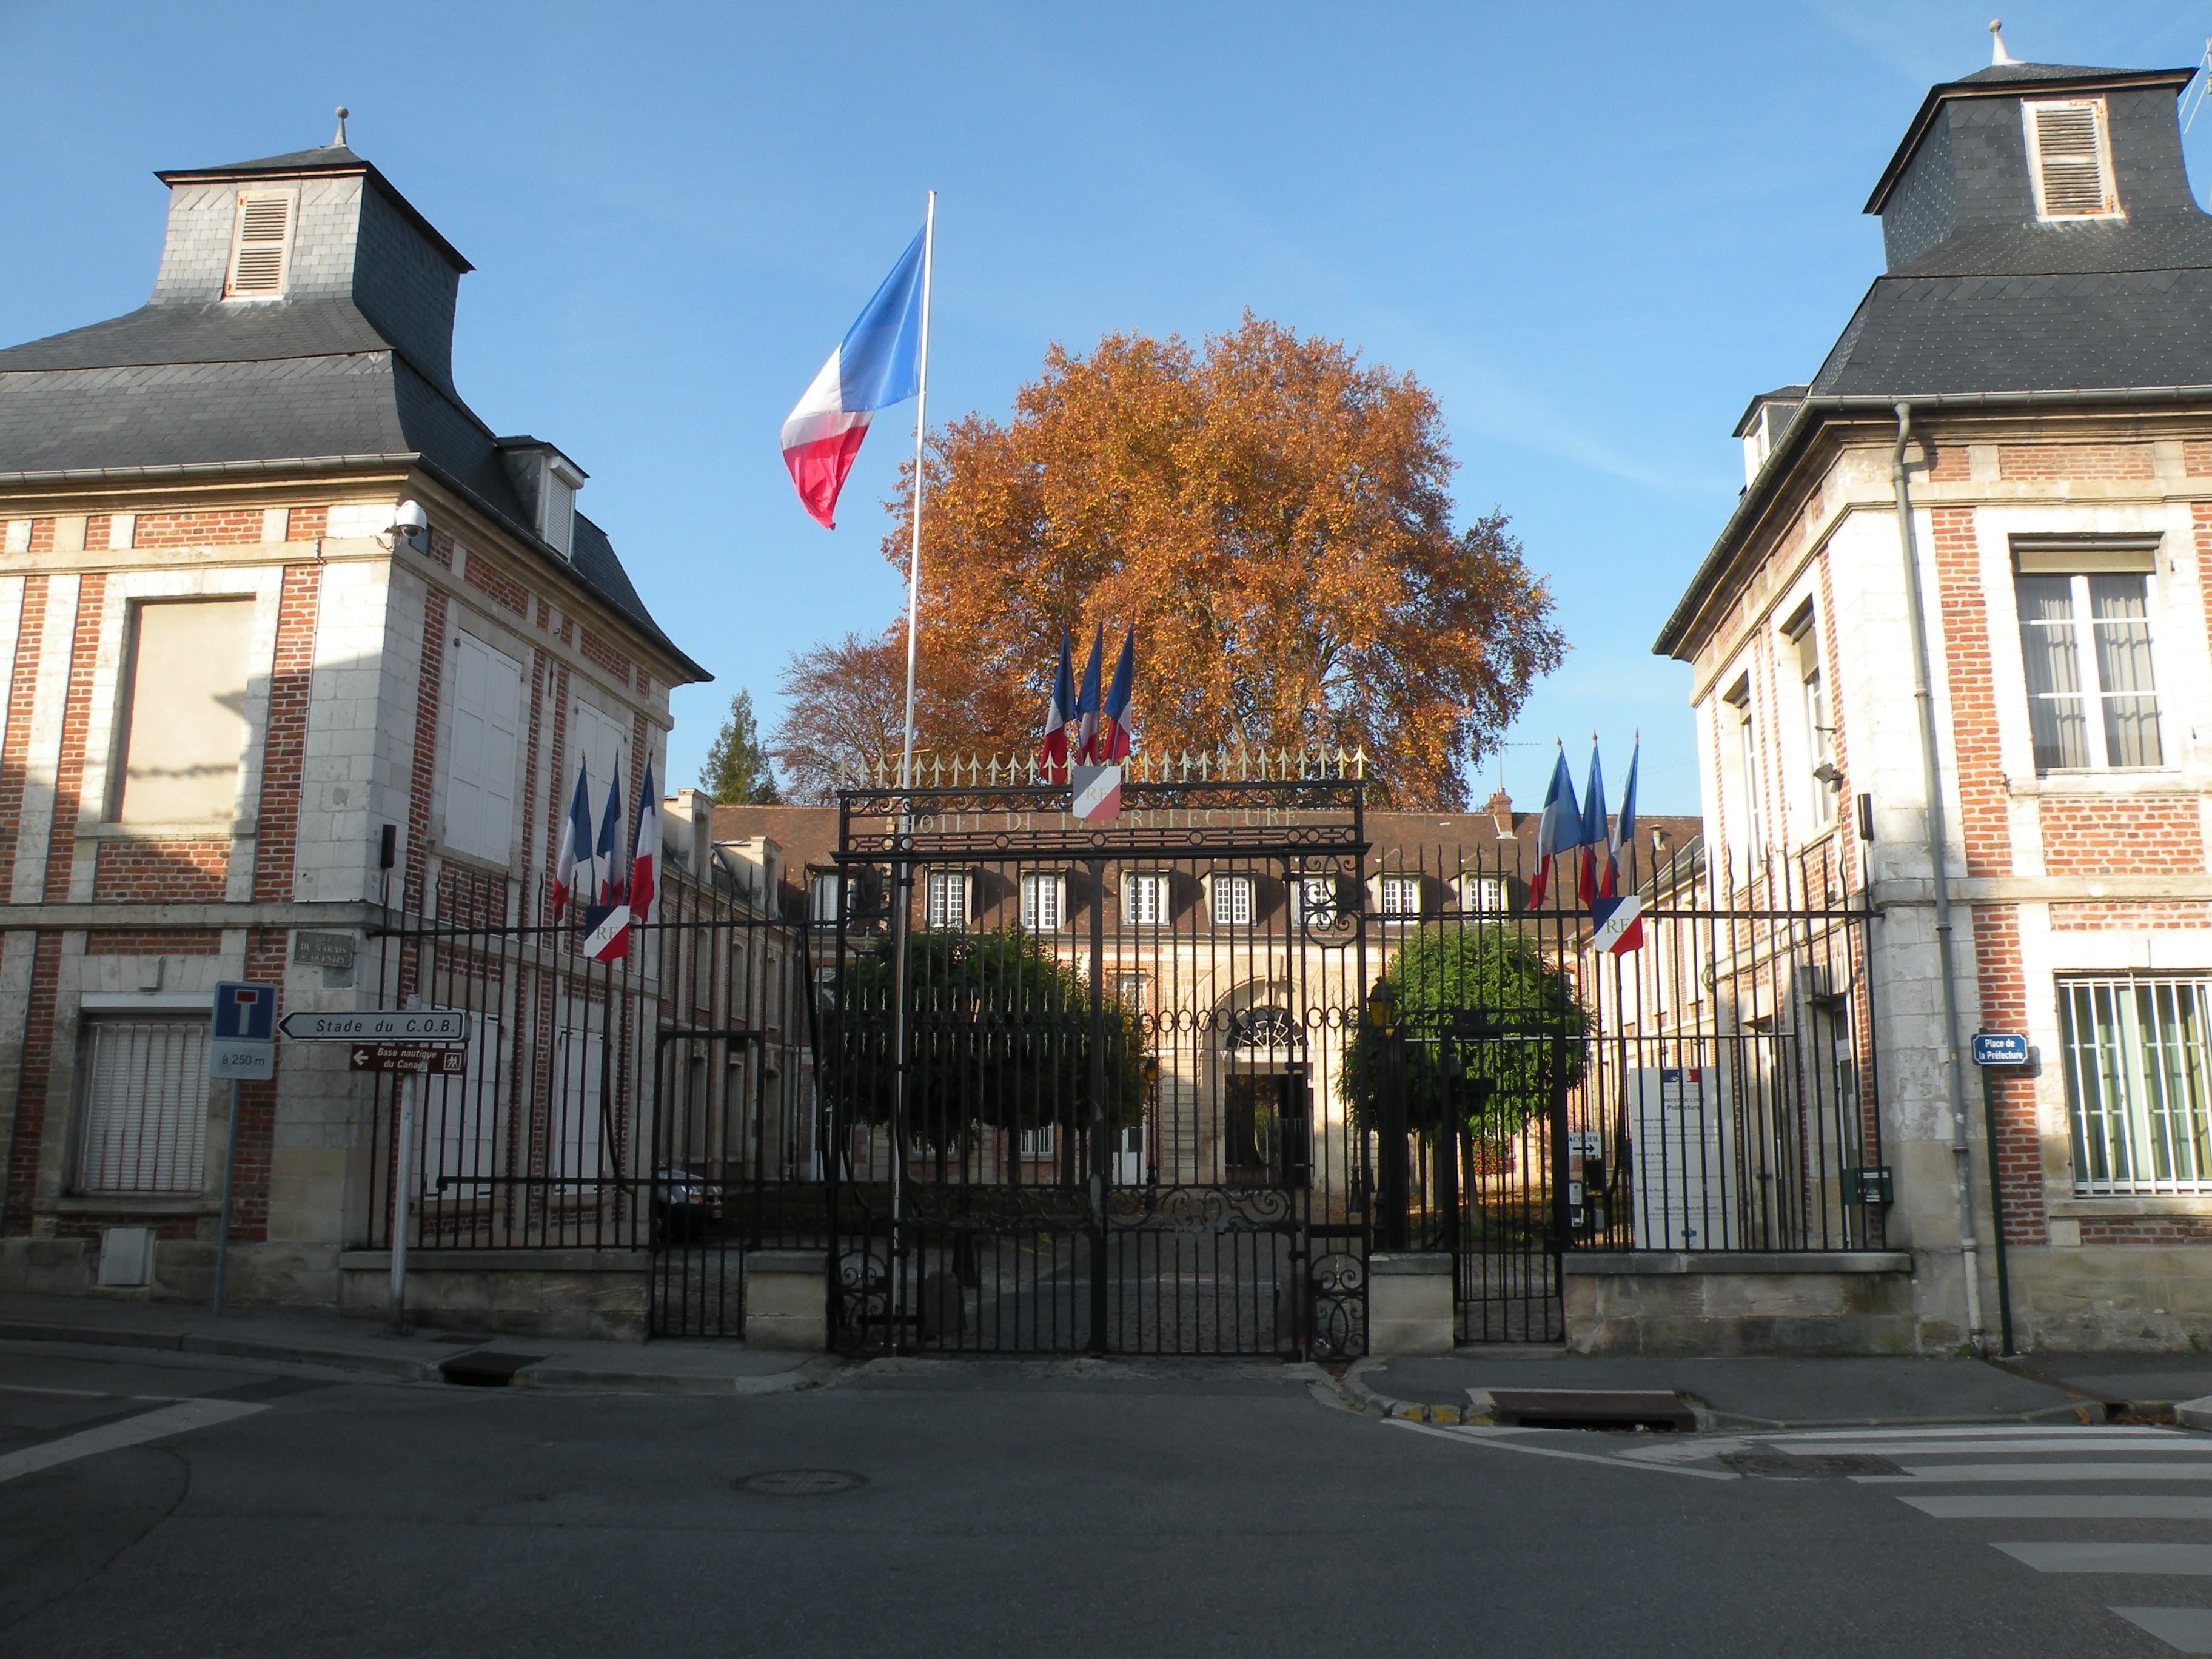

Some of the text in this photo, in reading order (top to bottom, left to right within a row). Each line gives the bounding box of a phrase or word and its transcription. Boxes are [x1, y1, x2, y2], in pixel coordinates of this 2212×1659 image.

[1086, 787, 1109, 801] RF
[1005, 811, 1040, 831] DE
[596, 925, 618, 940] RF
[1606, 918, 1631, 934] RF
[316, 1019, 455, 1033] Stade du C.O.B.
[1985, 1038, 2015, 1048] Place de
[222, 1054, 229, 1064] à
[232, 1054, 252, 1065] 250
[377, 1047, 437, 1059] Base nautique
[1986, 1050, 2023, 1060] Préfecture
[384, 1059, 429, 1070] du Canada
